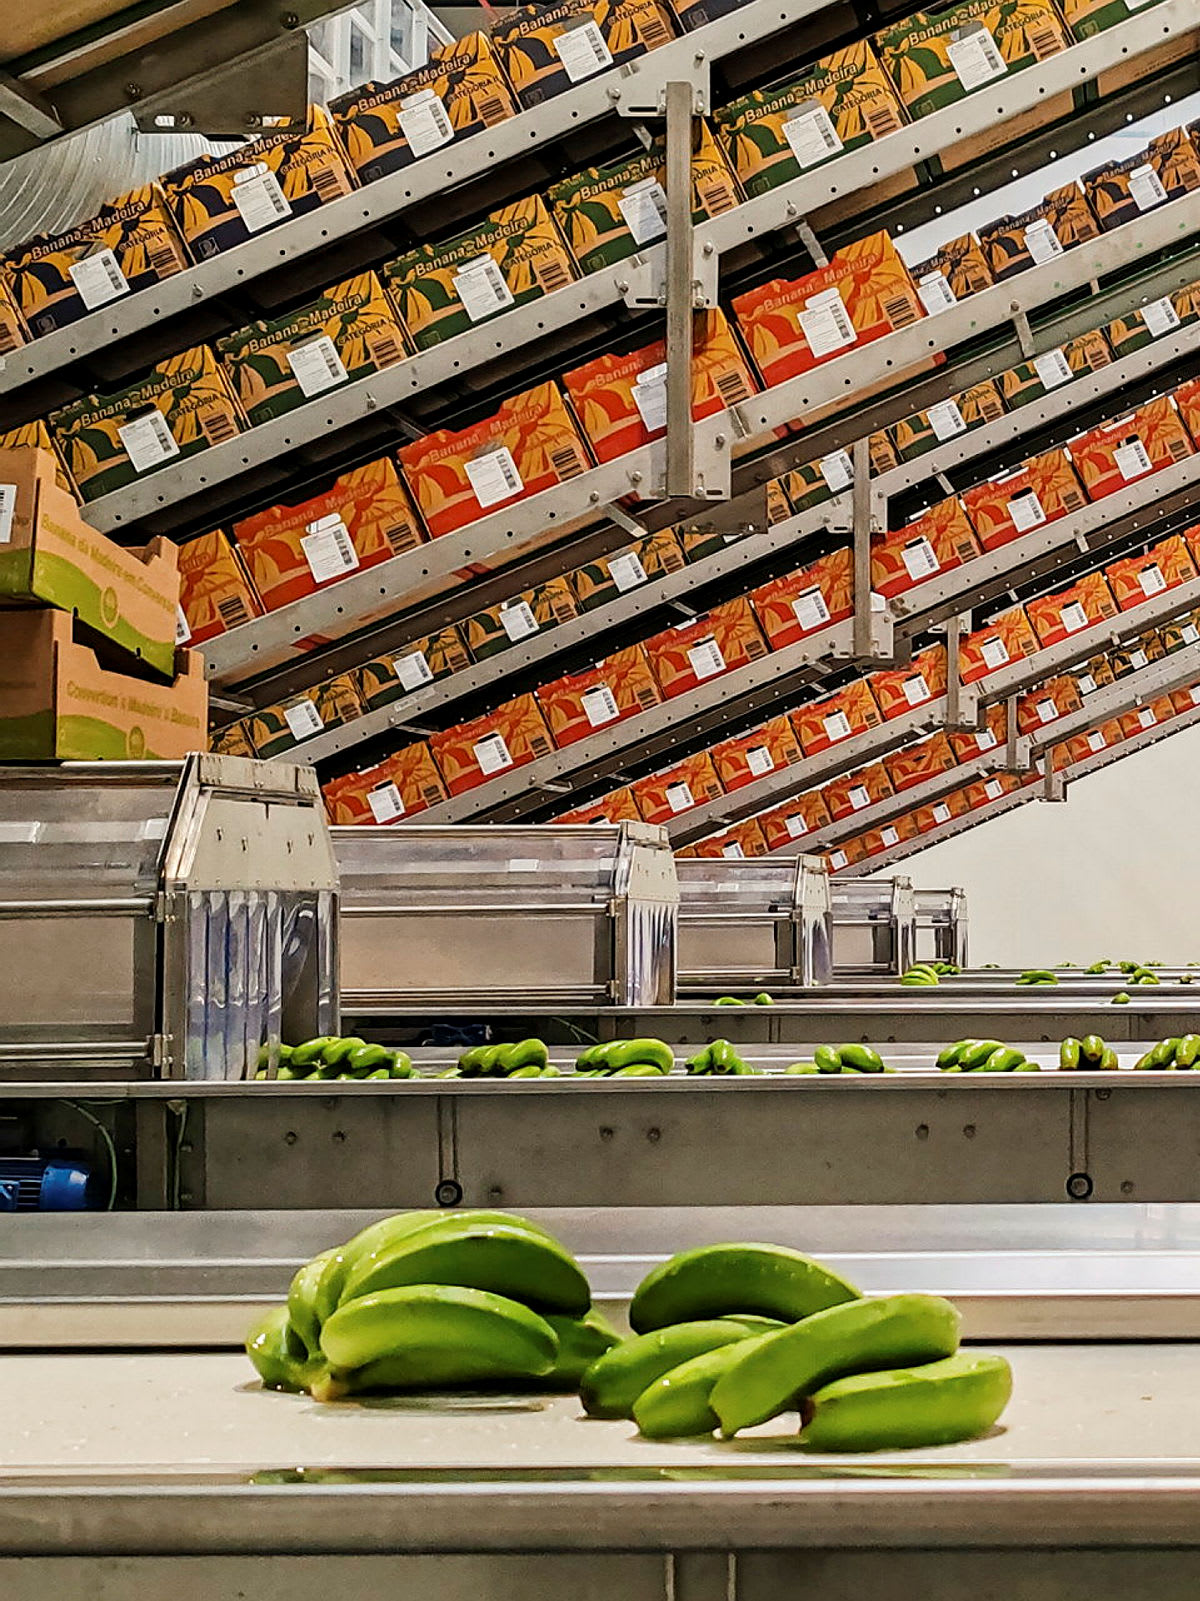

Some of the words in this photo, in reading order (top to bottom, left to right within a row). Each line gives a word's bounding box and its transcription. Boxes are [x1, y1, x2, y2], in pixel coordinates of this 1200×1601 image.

[519, 5, 570, 36] Banana
[908, 16, 959, 46] Banana
[358, 82, 408, 112] Banana
[417, 53, 470, 86] Madeira
[744, 93, 795, 124] Banana
[804, 64, 857, 96] Madeira
[194, 153, 245, 182] Banana
[580, 171, 631, 200] Banana
[31, 231, 82, 261] Banana
[91, 200, 145, 232] Madeira
[414, 247, 465, 276] Banana
[474, 217, 528, 249] Madeira
[248, 324, 299, 353] Banana
[309, 293, 362, 326] Madeira
[763, 283, 814, 312] Banana
[80, 398, 131, 427] Banana
[140, 367, 195, 400] Madeira
